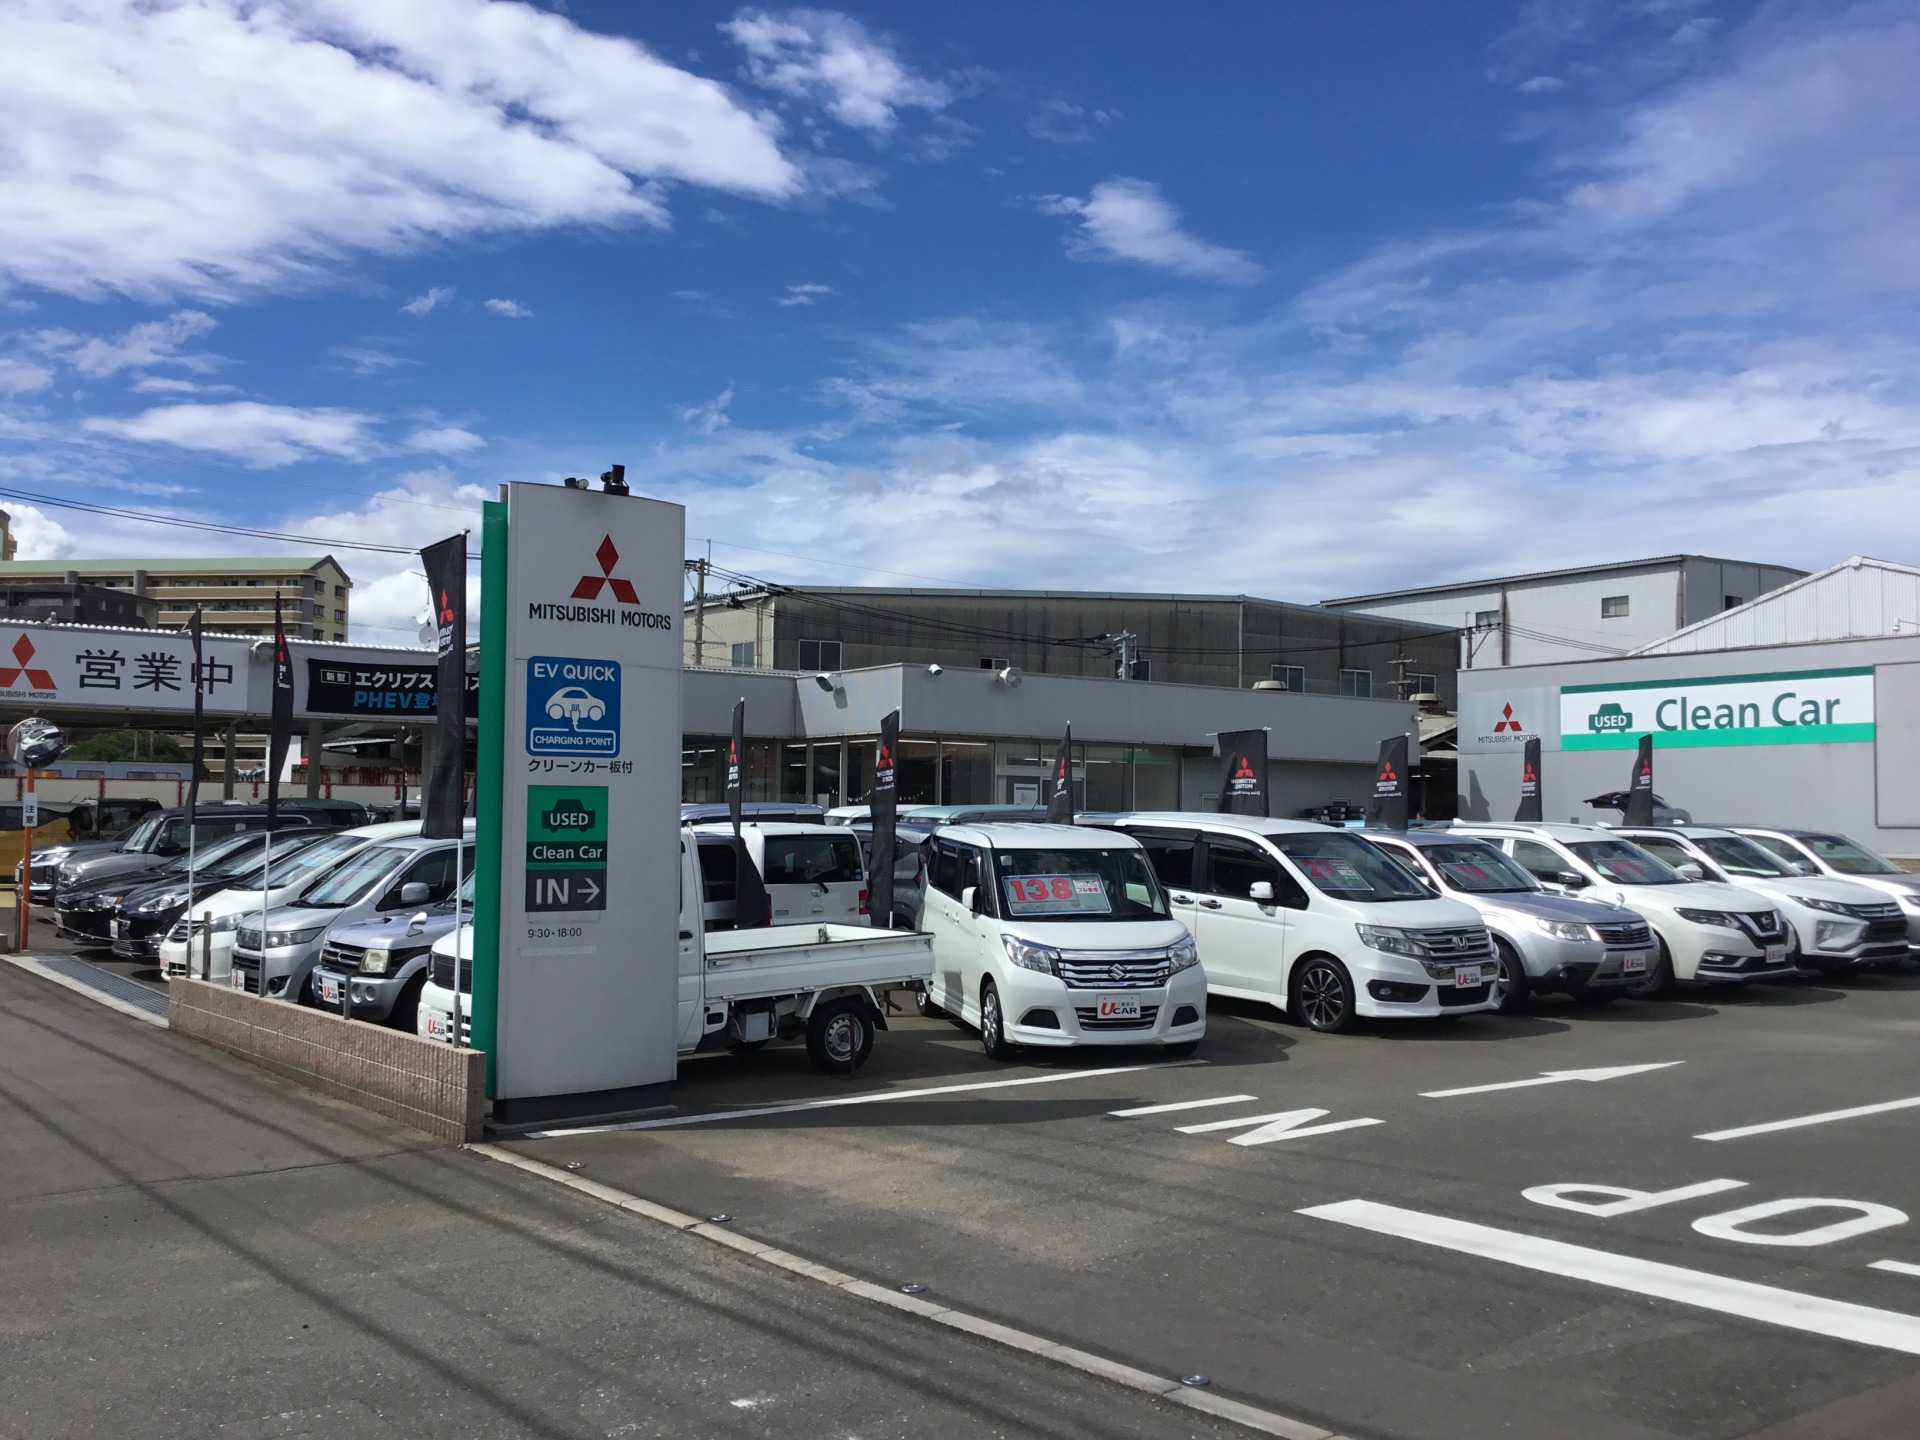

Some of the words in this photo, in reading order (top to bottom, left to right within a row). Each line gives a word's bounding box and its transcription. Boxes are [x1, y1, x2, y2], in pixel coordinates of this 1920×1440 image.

[528, 603, 615, 624] MITSUBISHI
[620, 610, 672, 631] MOTORS
[75, 648, 233, 695] 営業中
[326, 671, 346, 682] 新型
[355, 671, 434, 689] エクリプス
[534, 662, 559, 678] EV
[563, 664, 616, 682] QUICK
[28, 691, 56, 700] MOTORS
[1594, 715, 1628, 728] USED
[1655, 696, 1761, 732] Clean
[1772, 692, 1841, 727] Car
[534, 734, 584, 746] CHARGING
[585, 736, 613, 746] POINT
[1477, 734, 1512, 744] MITSUBISHI
[528, 758, 633, 774] クリーンカー板付
[24, 804, 35, 824] 注意
[549, 812, 589, 826] USED
[532, 844, 575, 860] Clean
[579, 845, 604, 859] Car
[535, 877, 570, 905] IN
[1009, 878, 1072, 901] 138
[1107, 1093, 1386, 1147] IN
